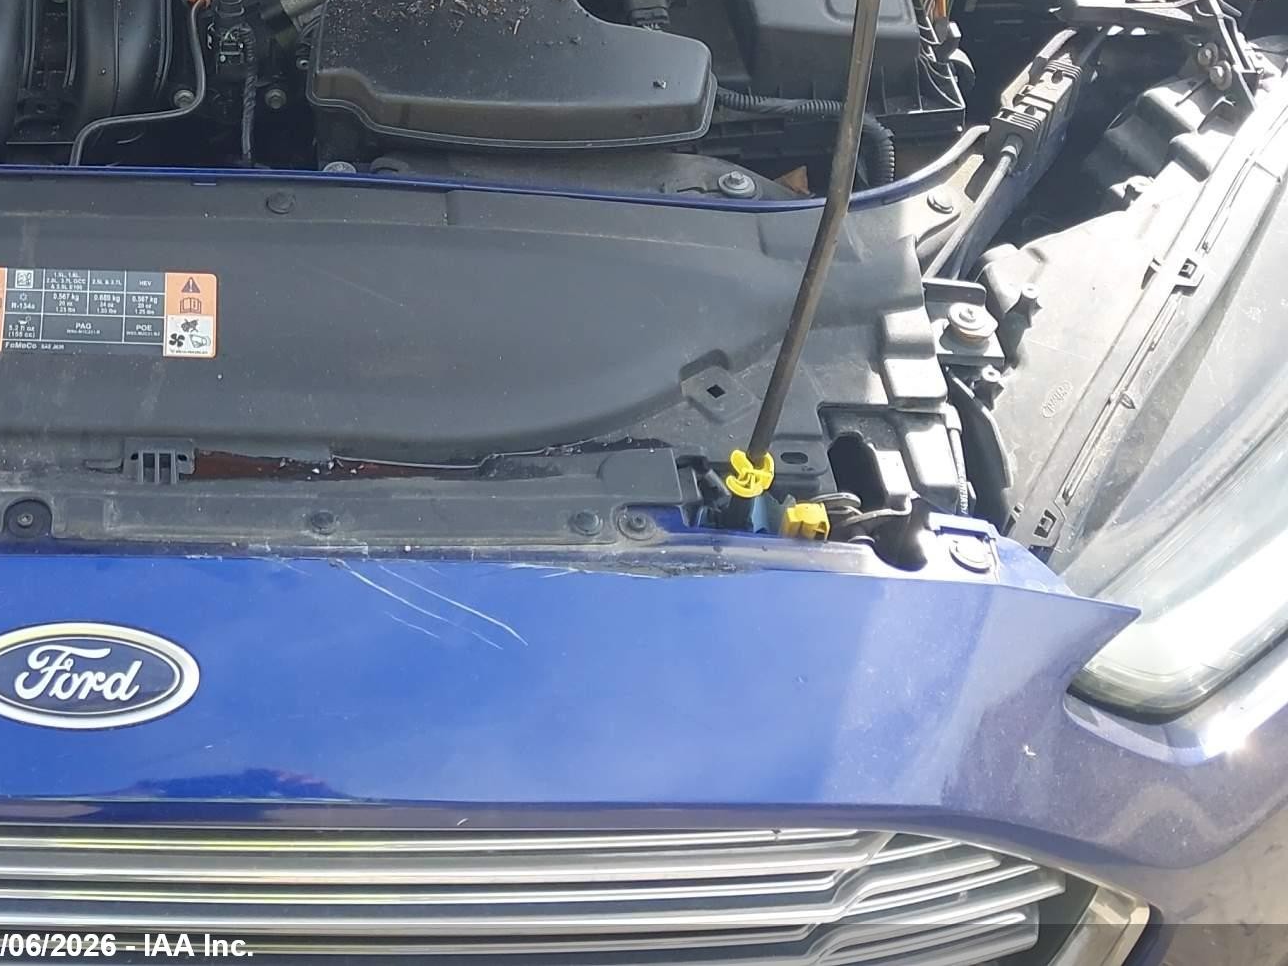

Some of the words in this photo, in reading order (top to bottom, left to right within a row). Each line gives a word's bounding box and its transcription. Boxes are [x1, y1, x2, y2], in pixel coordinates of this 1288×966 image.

[71, 293, 80, 302] kg
[112, 294, 121, 303] kg
[149, 295, 158, 304] kg
[75, 322, 92, 330] PAG
[4, 341, 37, 349] FoMoCo
[14, 644, 143, 701] Ford
